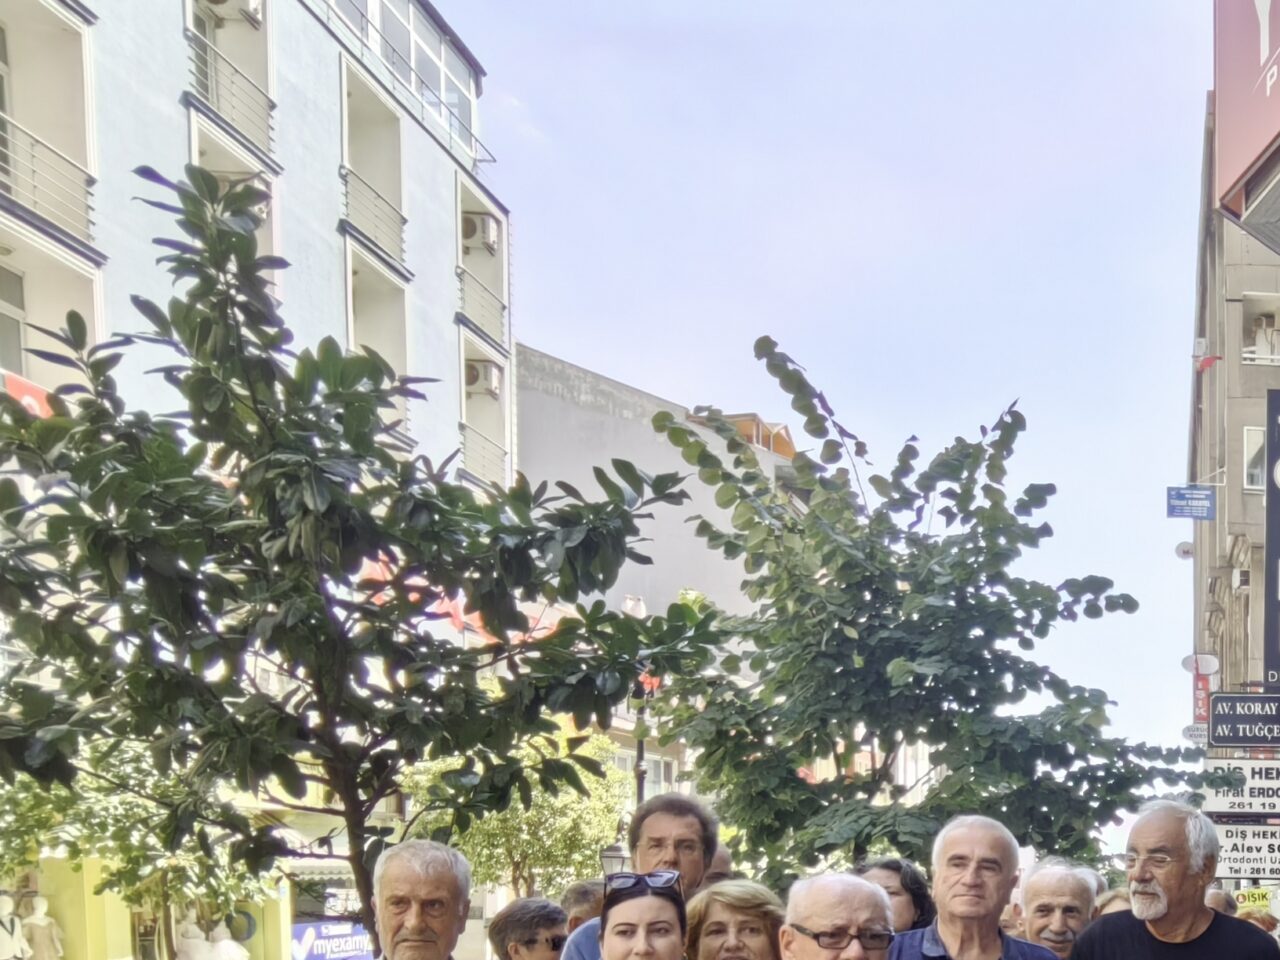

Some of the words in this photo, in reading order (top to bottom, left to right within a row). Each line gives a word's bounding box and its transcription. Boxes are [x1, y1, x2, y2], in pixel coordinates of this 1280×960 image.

[1215, 703, 1233, 714] AV.
[1236, 703, 1278, 715] KORAY
[1215, 725, 1233, 736] AV.
[1236, 723, 1280, 740] TUĞÇE
[1228, 802, 1253, 810] 261
[1260, 802, 1276, 810] 19
[1225, 828, 1247, 842] DİŞ
[1250, 867, 1266, 875] 261
